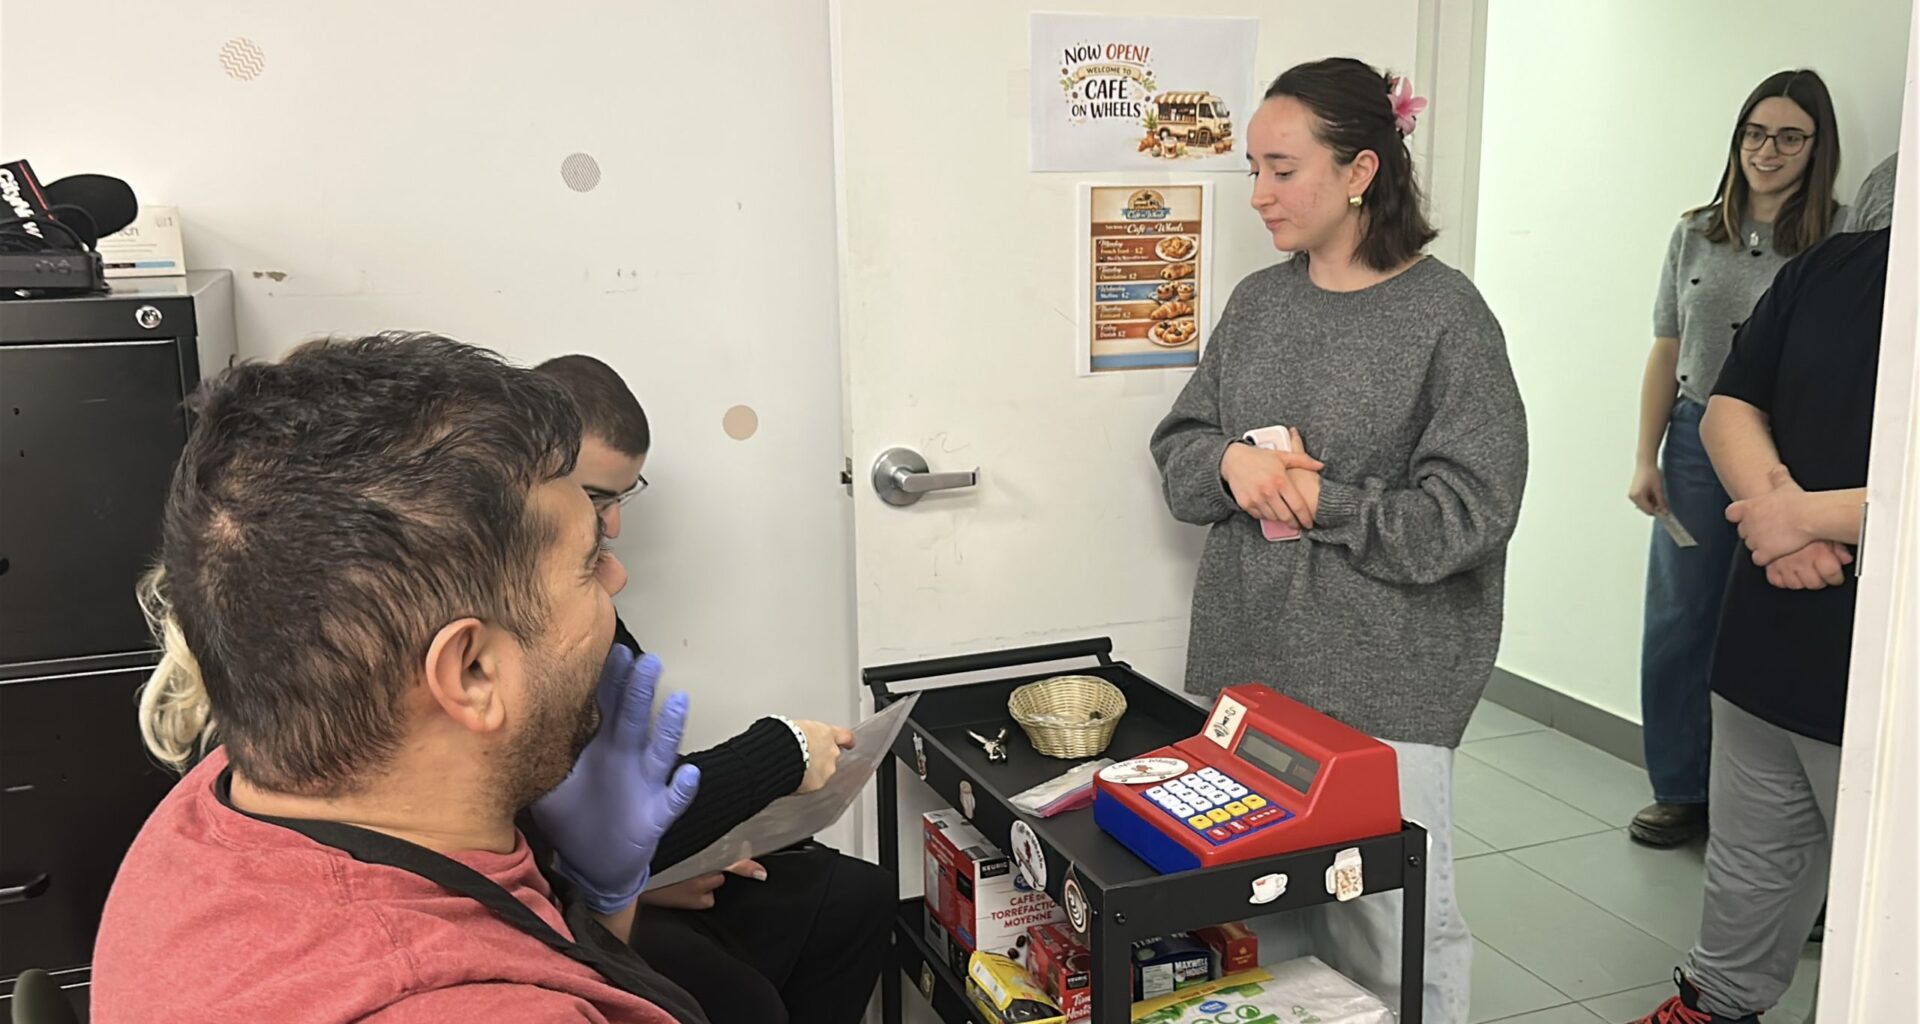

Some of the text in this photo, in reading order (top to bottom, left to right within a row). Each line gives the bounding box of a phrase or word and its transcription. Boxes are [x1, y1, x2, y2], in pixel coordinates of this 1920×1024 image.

[1064, 43, 1150, 65] NOW OPEN!
[1086, 66, 1120, 74] WELCOME
[1084, 76, 1128, 100] CAFÉ
[1071, 101, 1142, 119] ON WHEELS
[1154, 222, 1184, 233] Wheels
[1010, 893, 1034, 906] CAFÉ
[991, 901, 1057, 920] TORRÉFACTIO
[1003, 910, 1053, 928] MOYENNE
[1175, 957, 1208, 970] MAXWELL
[1186, 966, 1208, 977] HOUSE
